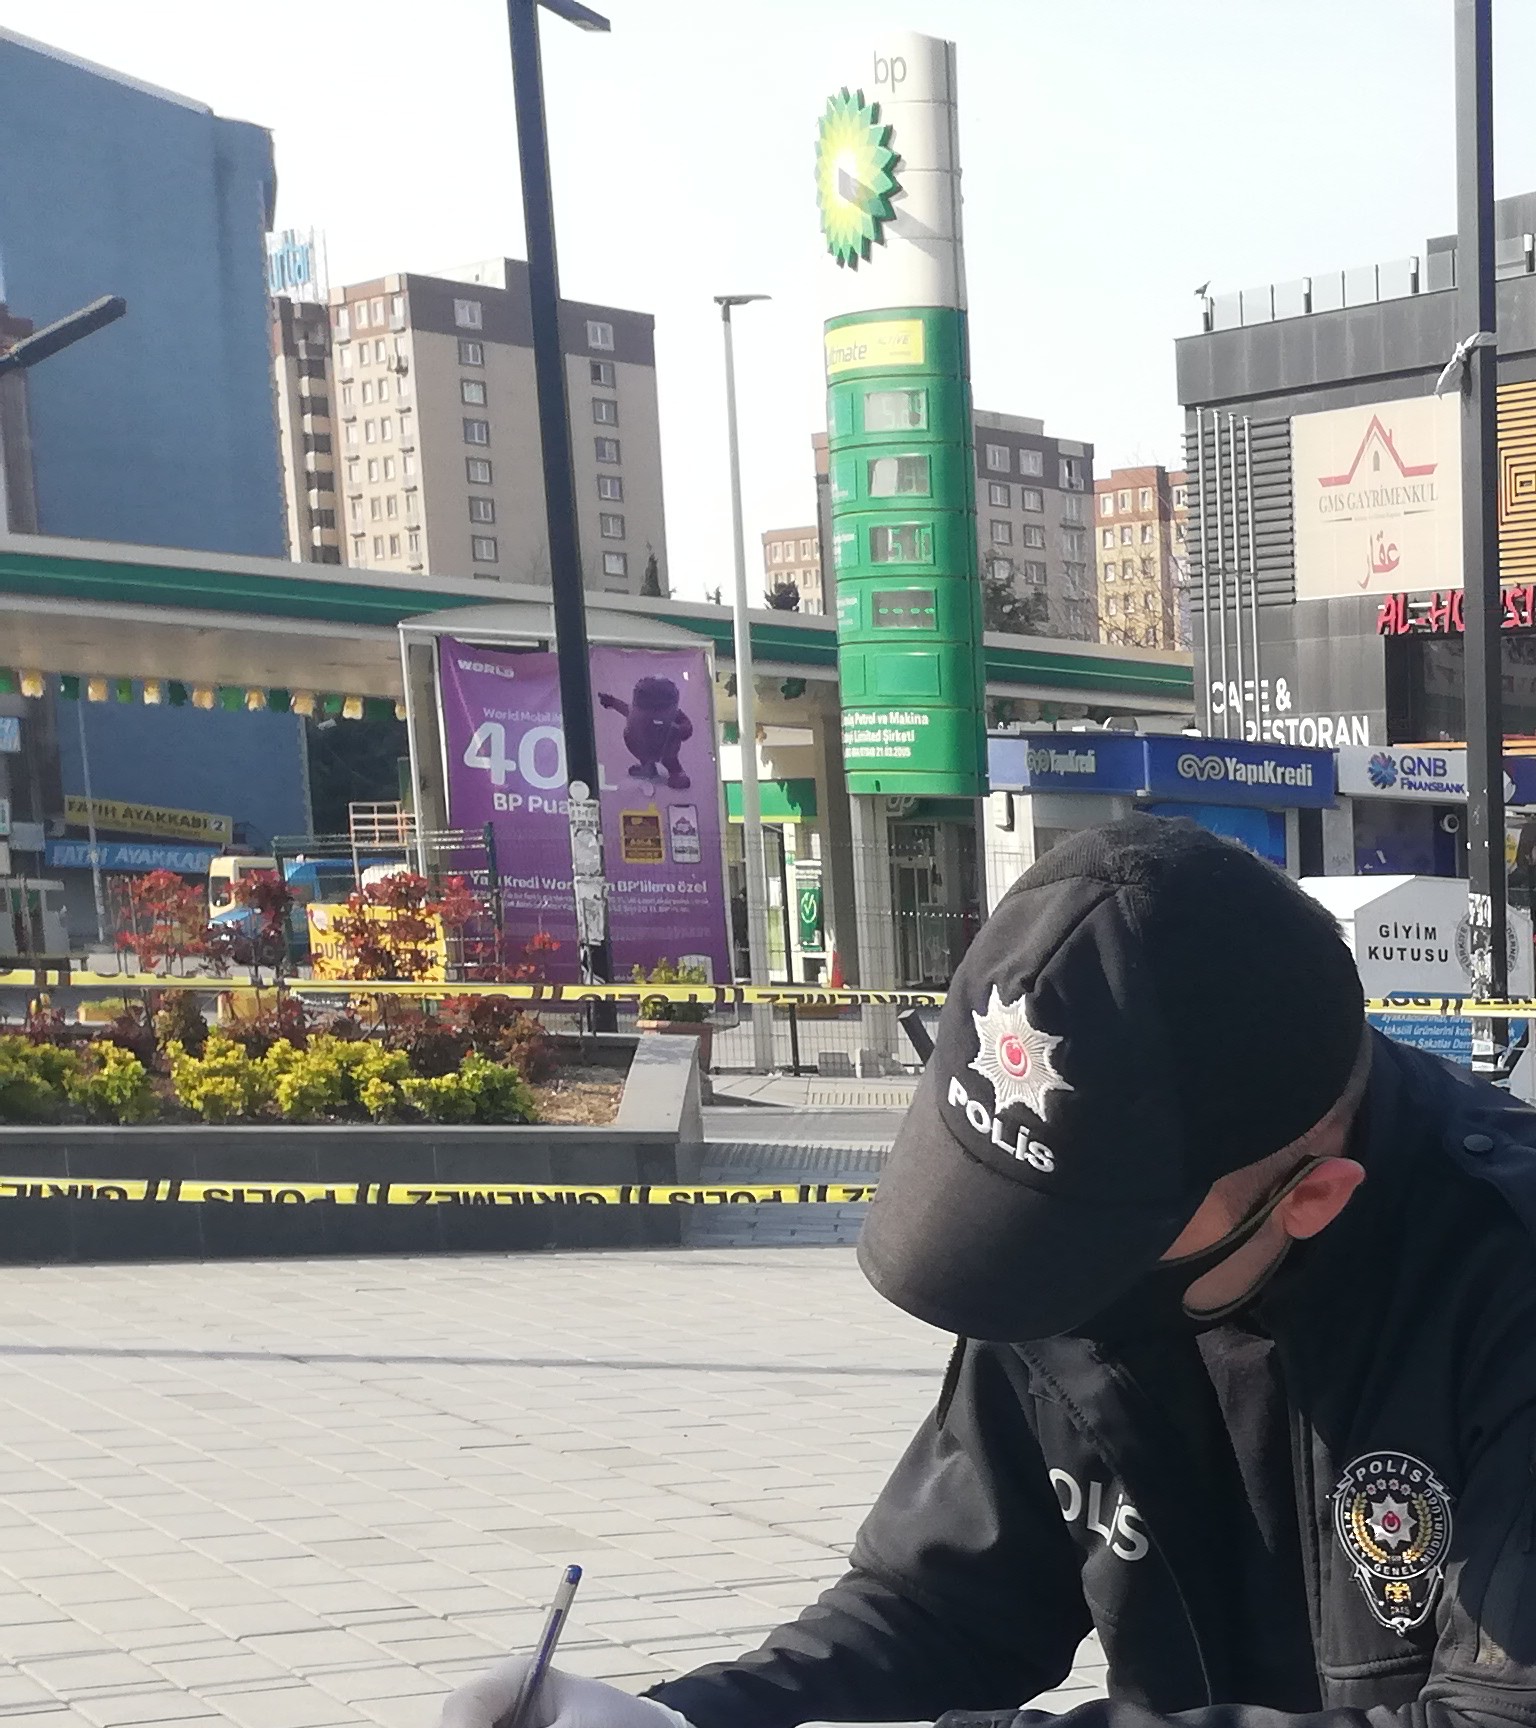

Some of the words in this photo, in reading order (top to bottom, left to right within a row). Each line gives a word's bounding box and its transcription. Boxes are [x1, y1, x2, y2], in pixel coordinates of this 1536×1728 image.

[873, 51, 907, 92] bp
[1319, 491, 1345, 514] GMS
[1347, 481, 1438, 512] GAYRİMENKUL
[1358, 529, 1401, 590] عقار
[457, 658, 515, 679] WORLD
[1275, 677, 1292, 711] &
[483, 707, 521, 722] World
[463, 721, 569, 790] 40
[1400, 754, 1448, 779] QNB
[1224, 757, 1314, 788] YapıKredi
[493, 792, 524, 813] BP
[503, 875, 540, 890] Kredi
[677, 880, 708, 894] özel
[1378, 921, 1438, 942] GİYİM
[1368, 945, 1450, 964] KUTUSU
[947, 1076, 1056, 1174] POLİS
[1355, 1458, 1425, 1484] POLİS
